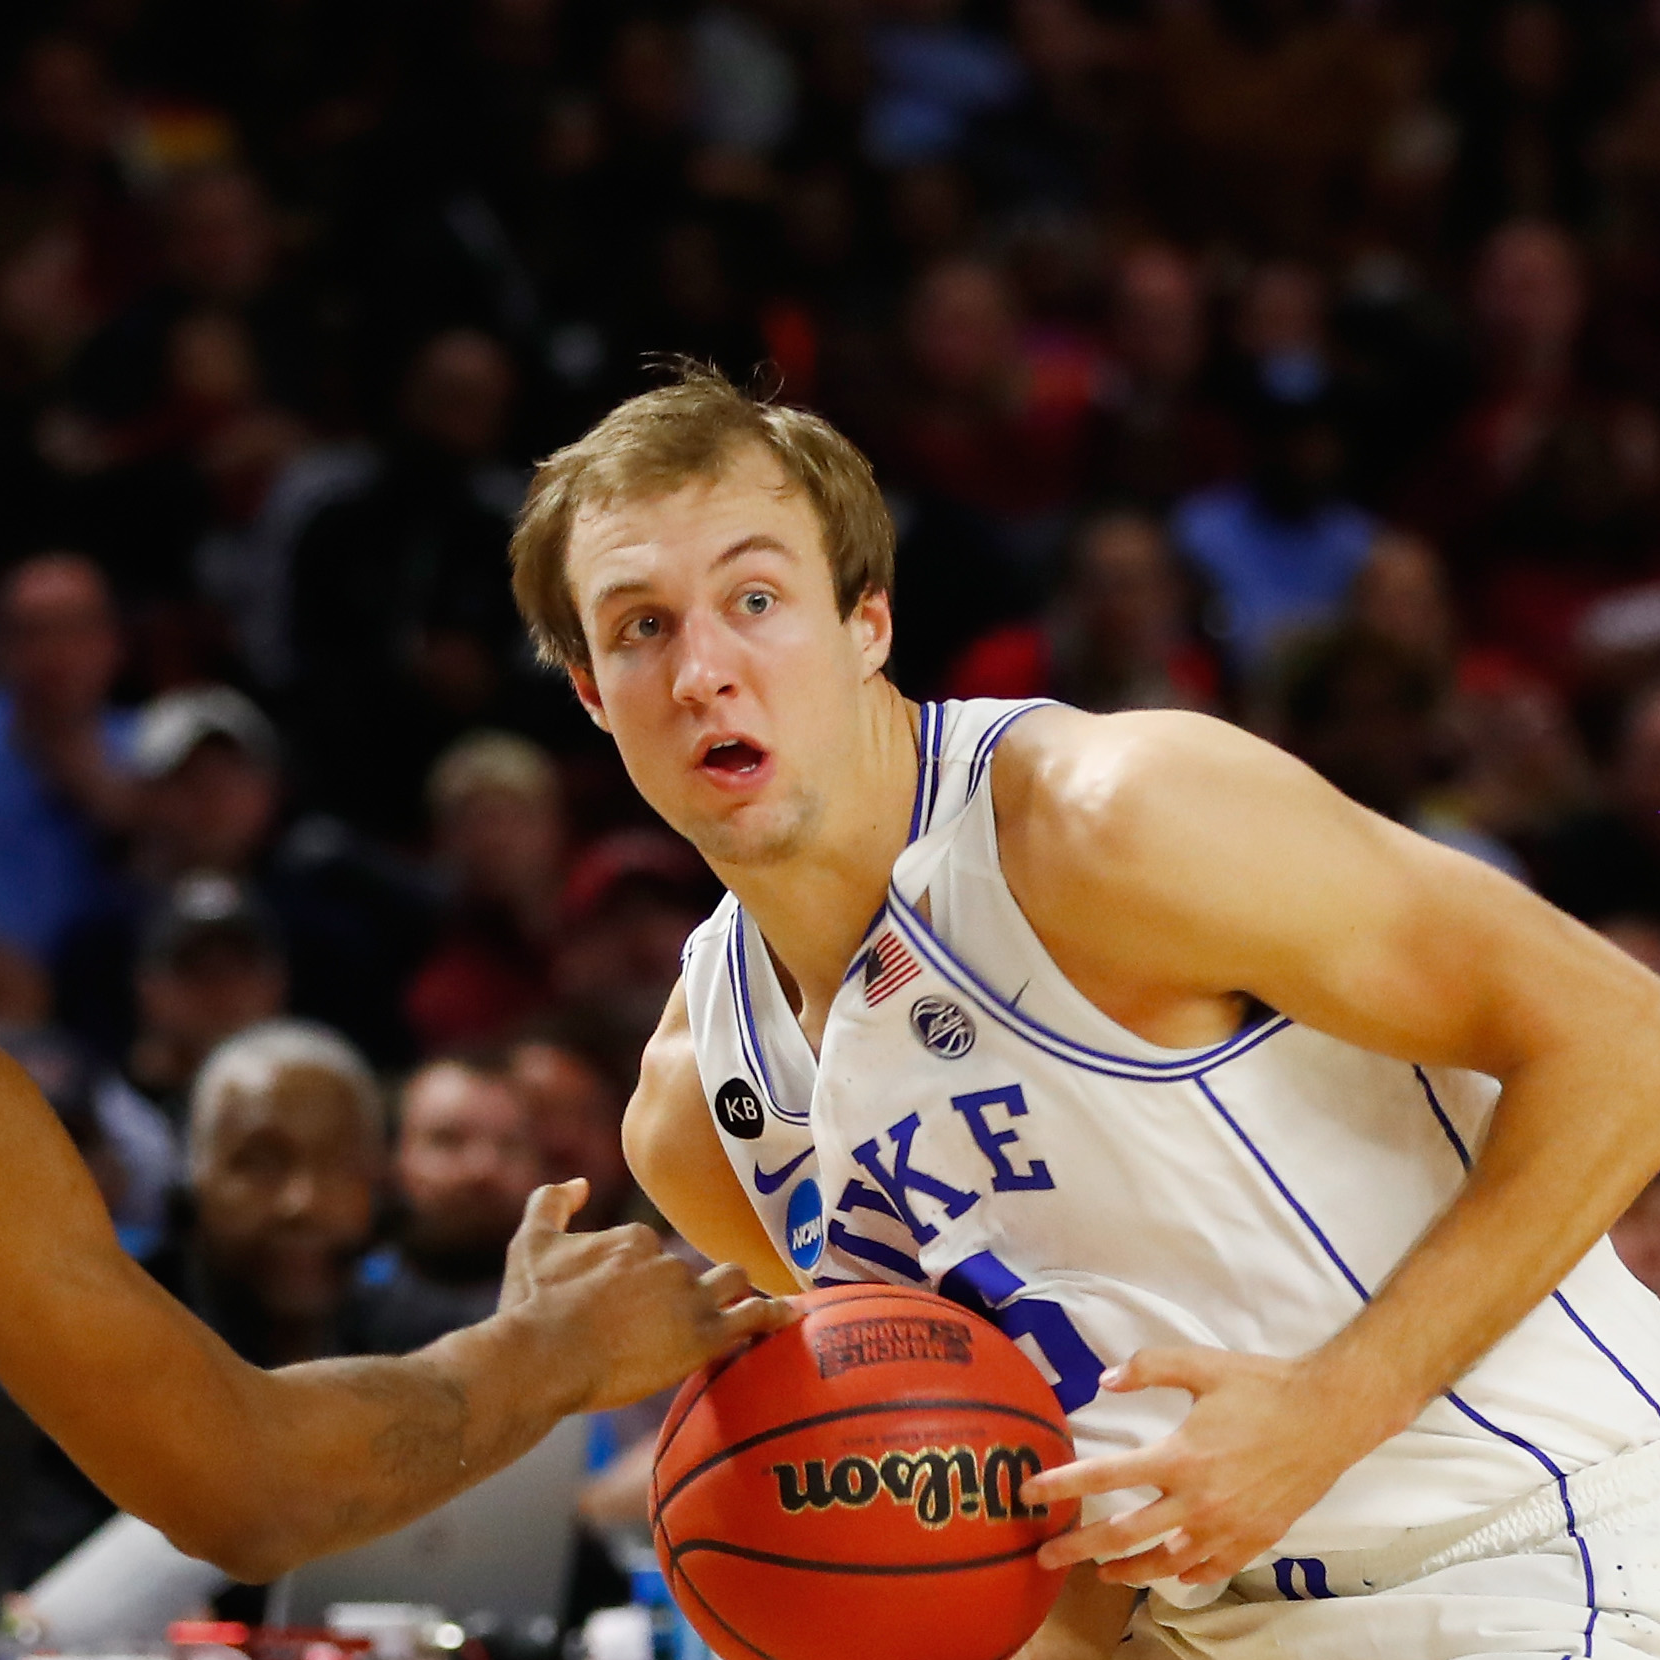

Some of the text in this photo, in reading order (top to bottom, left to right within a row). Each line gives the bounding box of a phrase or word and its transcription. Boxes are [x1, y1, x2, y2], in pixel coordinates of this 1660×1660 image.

[724, 1096, 759, 1122] KB
[813, 1083, 1057, 1286] UKE
[772, 1446, 1050, 1530] Wilson
